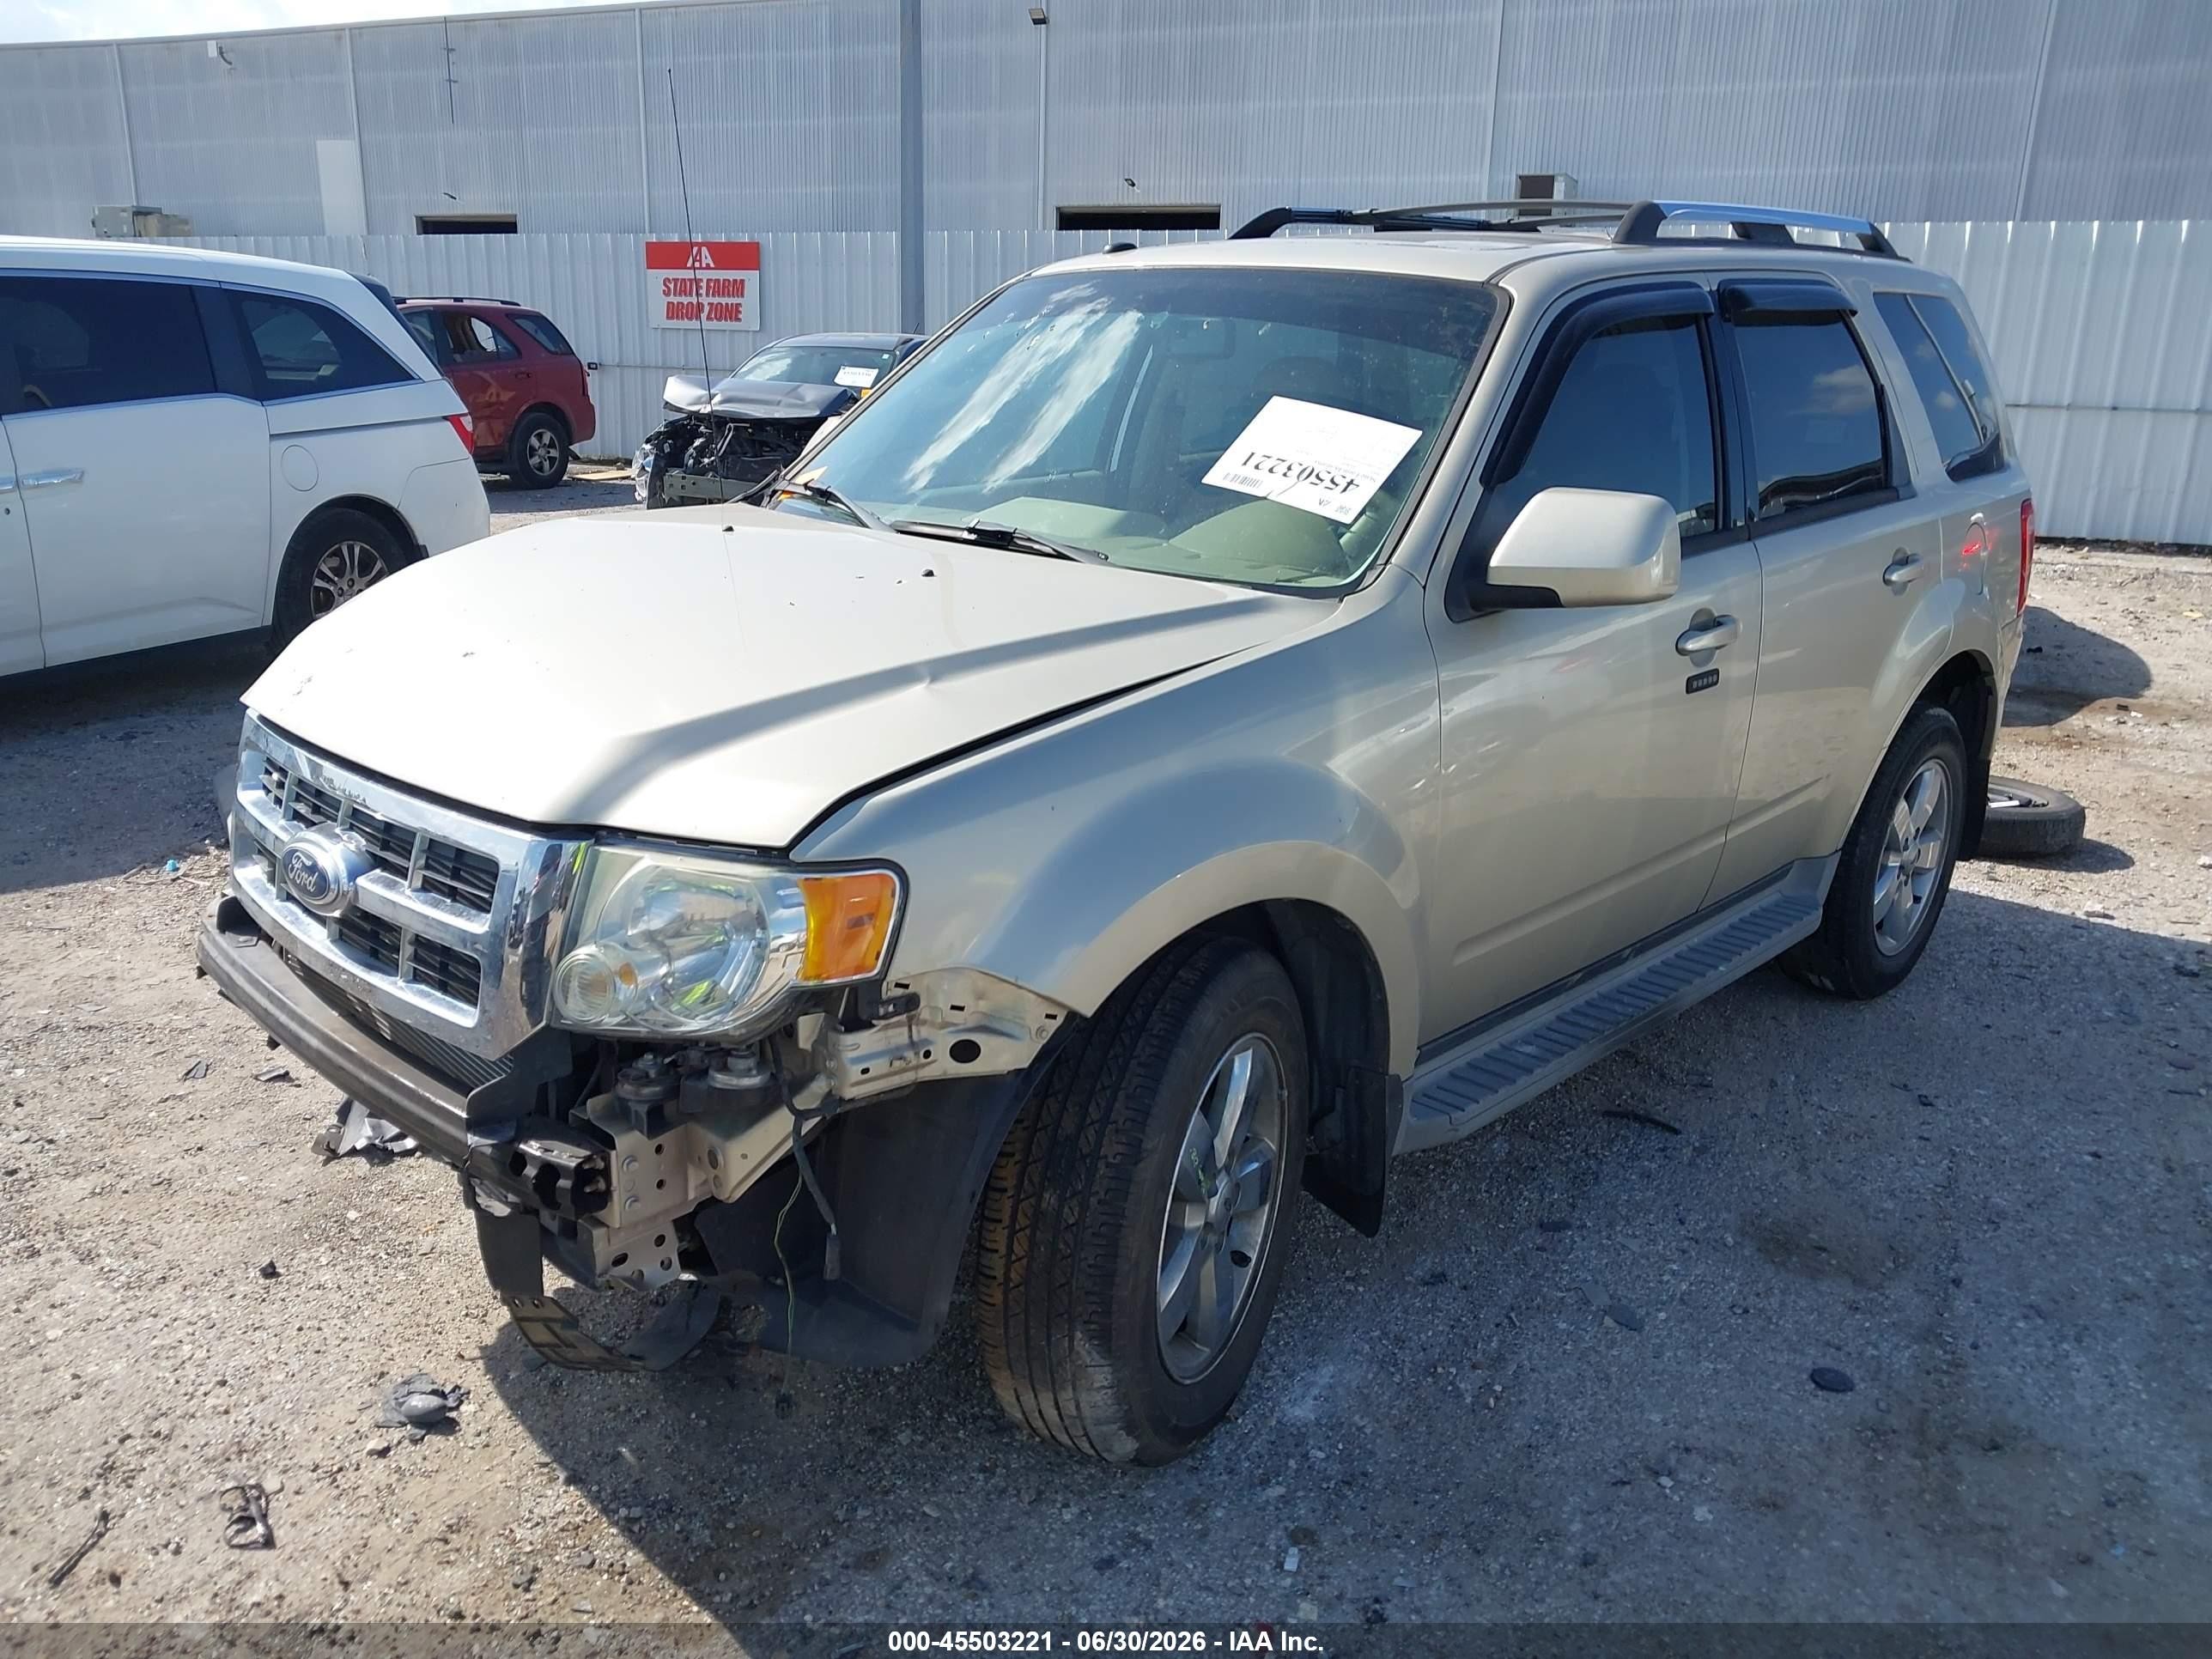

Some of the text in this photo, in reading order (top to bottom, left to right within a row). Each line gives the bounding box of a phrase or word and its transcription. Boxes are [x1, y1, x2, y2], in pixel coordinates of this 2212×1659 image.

[662, 276, 745, 299] STATE FARM
[665, 301, 743, 323] DROP ZONE
[1241, 452, 1360, 495] 45503221
[289, 852, 319, 891] Ford
